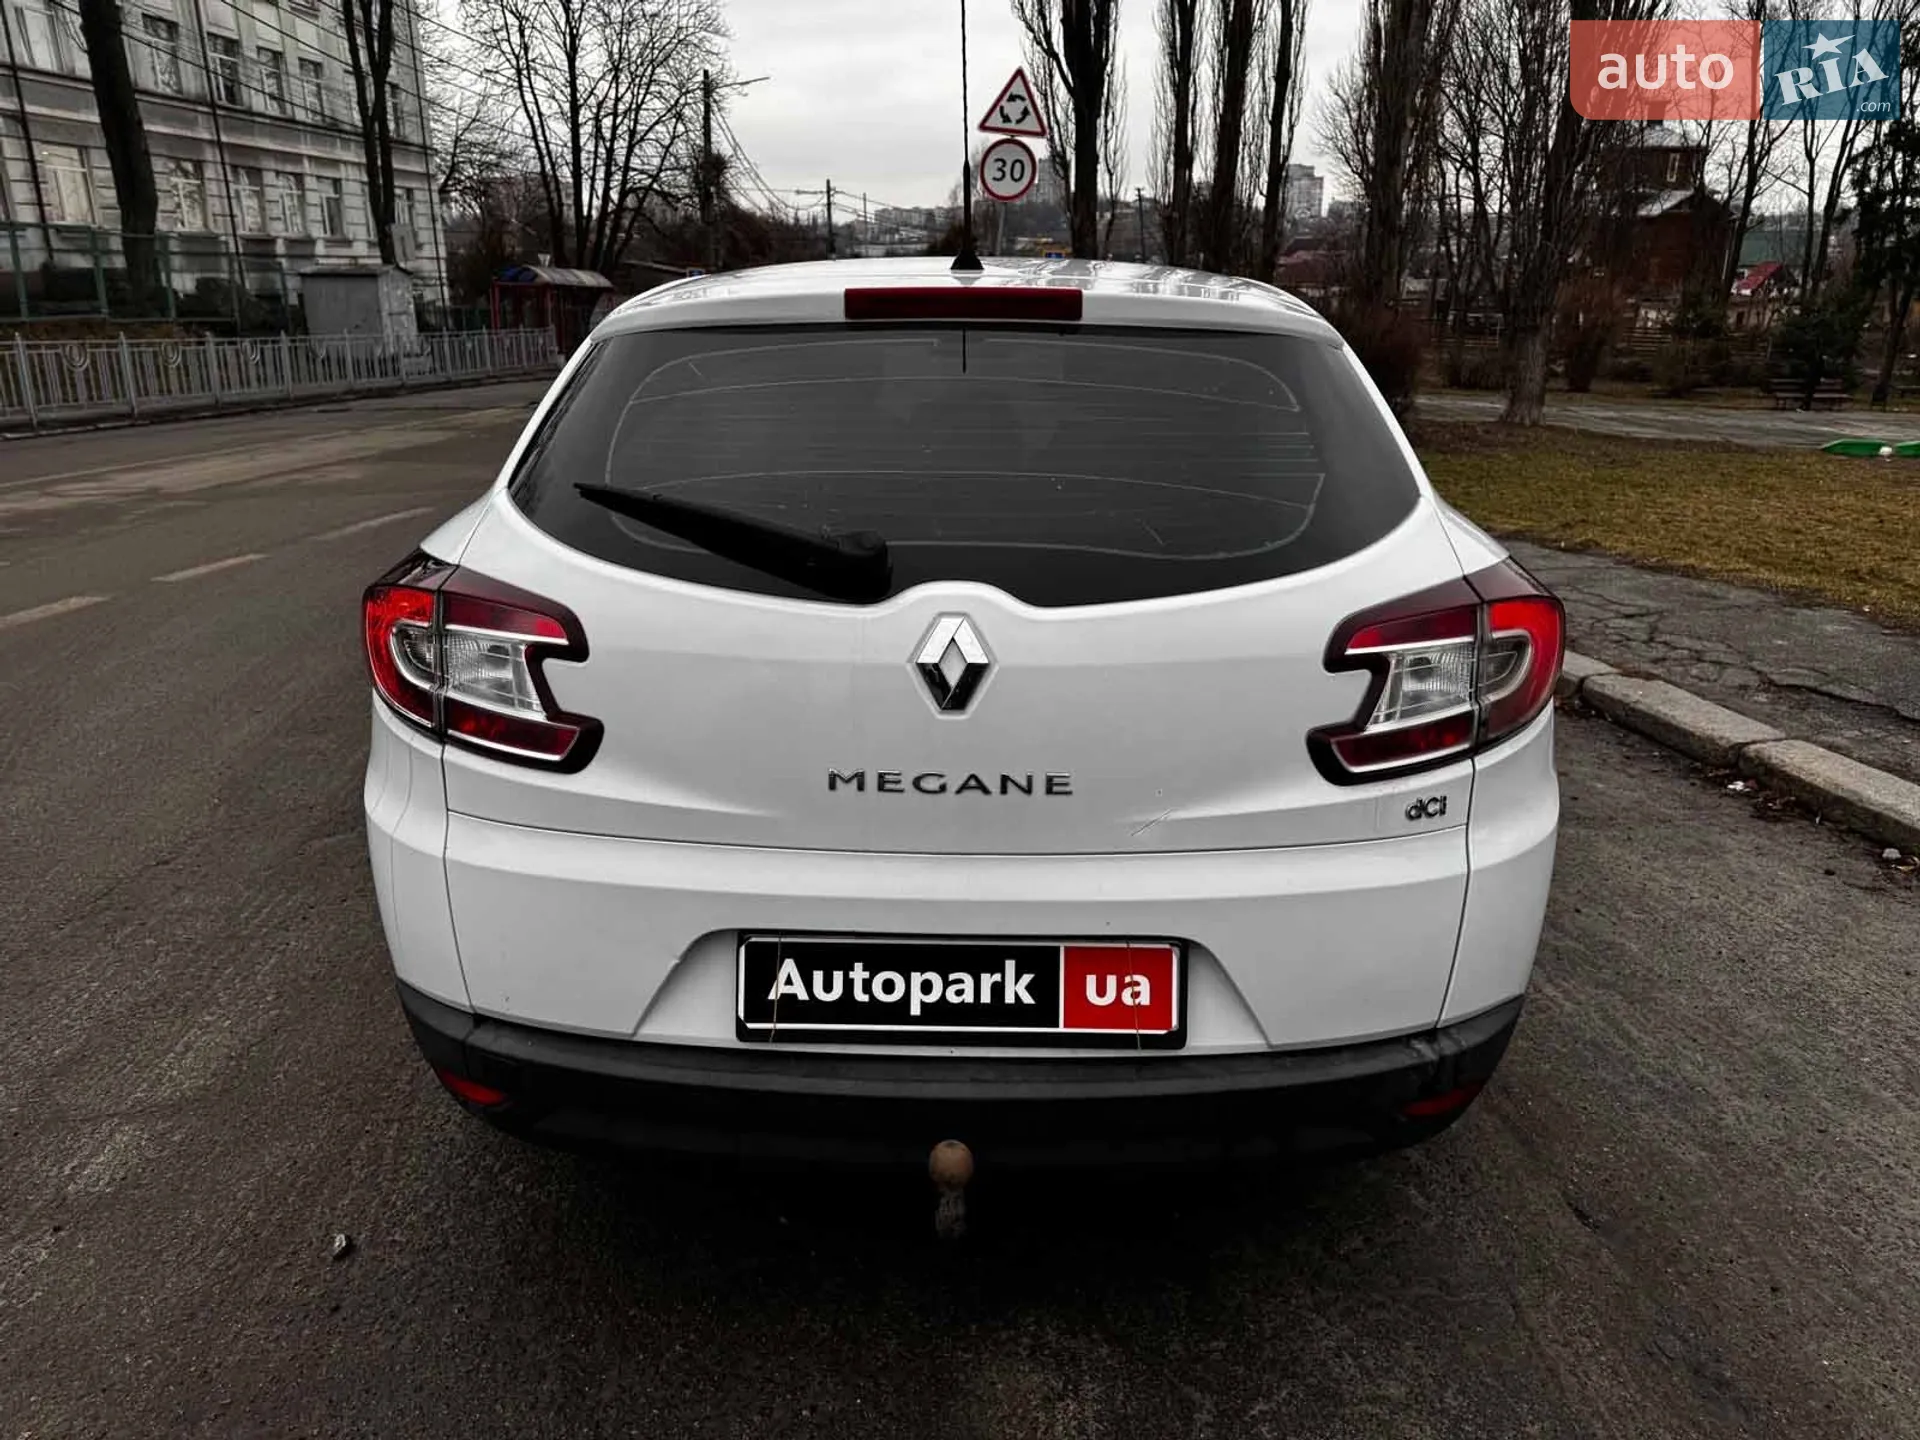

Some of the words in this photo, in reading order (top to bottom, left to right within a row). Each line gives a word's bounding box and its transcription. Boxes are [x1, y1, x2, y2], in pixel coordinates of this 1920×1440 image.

[992, 158, 1025, 182] 30
[827, 768, 1073, 796] MEGANE
[1405, 795, 1447, 821] dCi
[767, 957, 1036, 1016] Autopark
[1085, 973, 1151, 1006] ua
